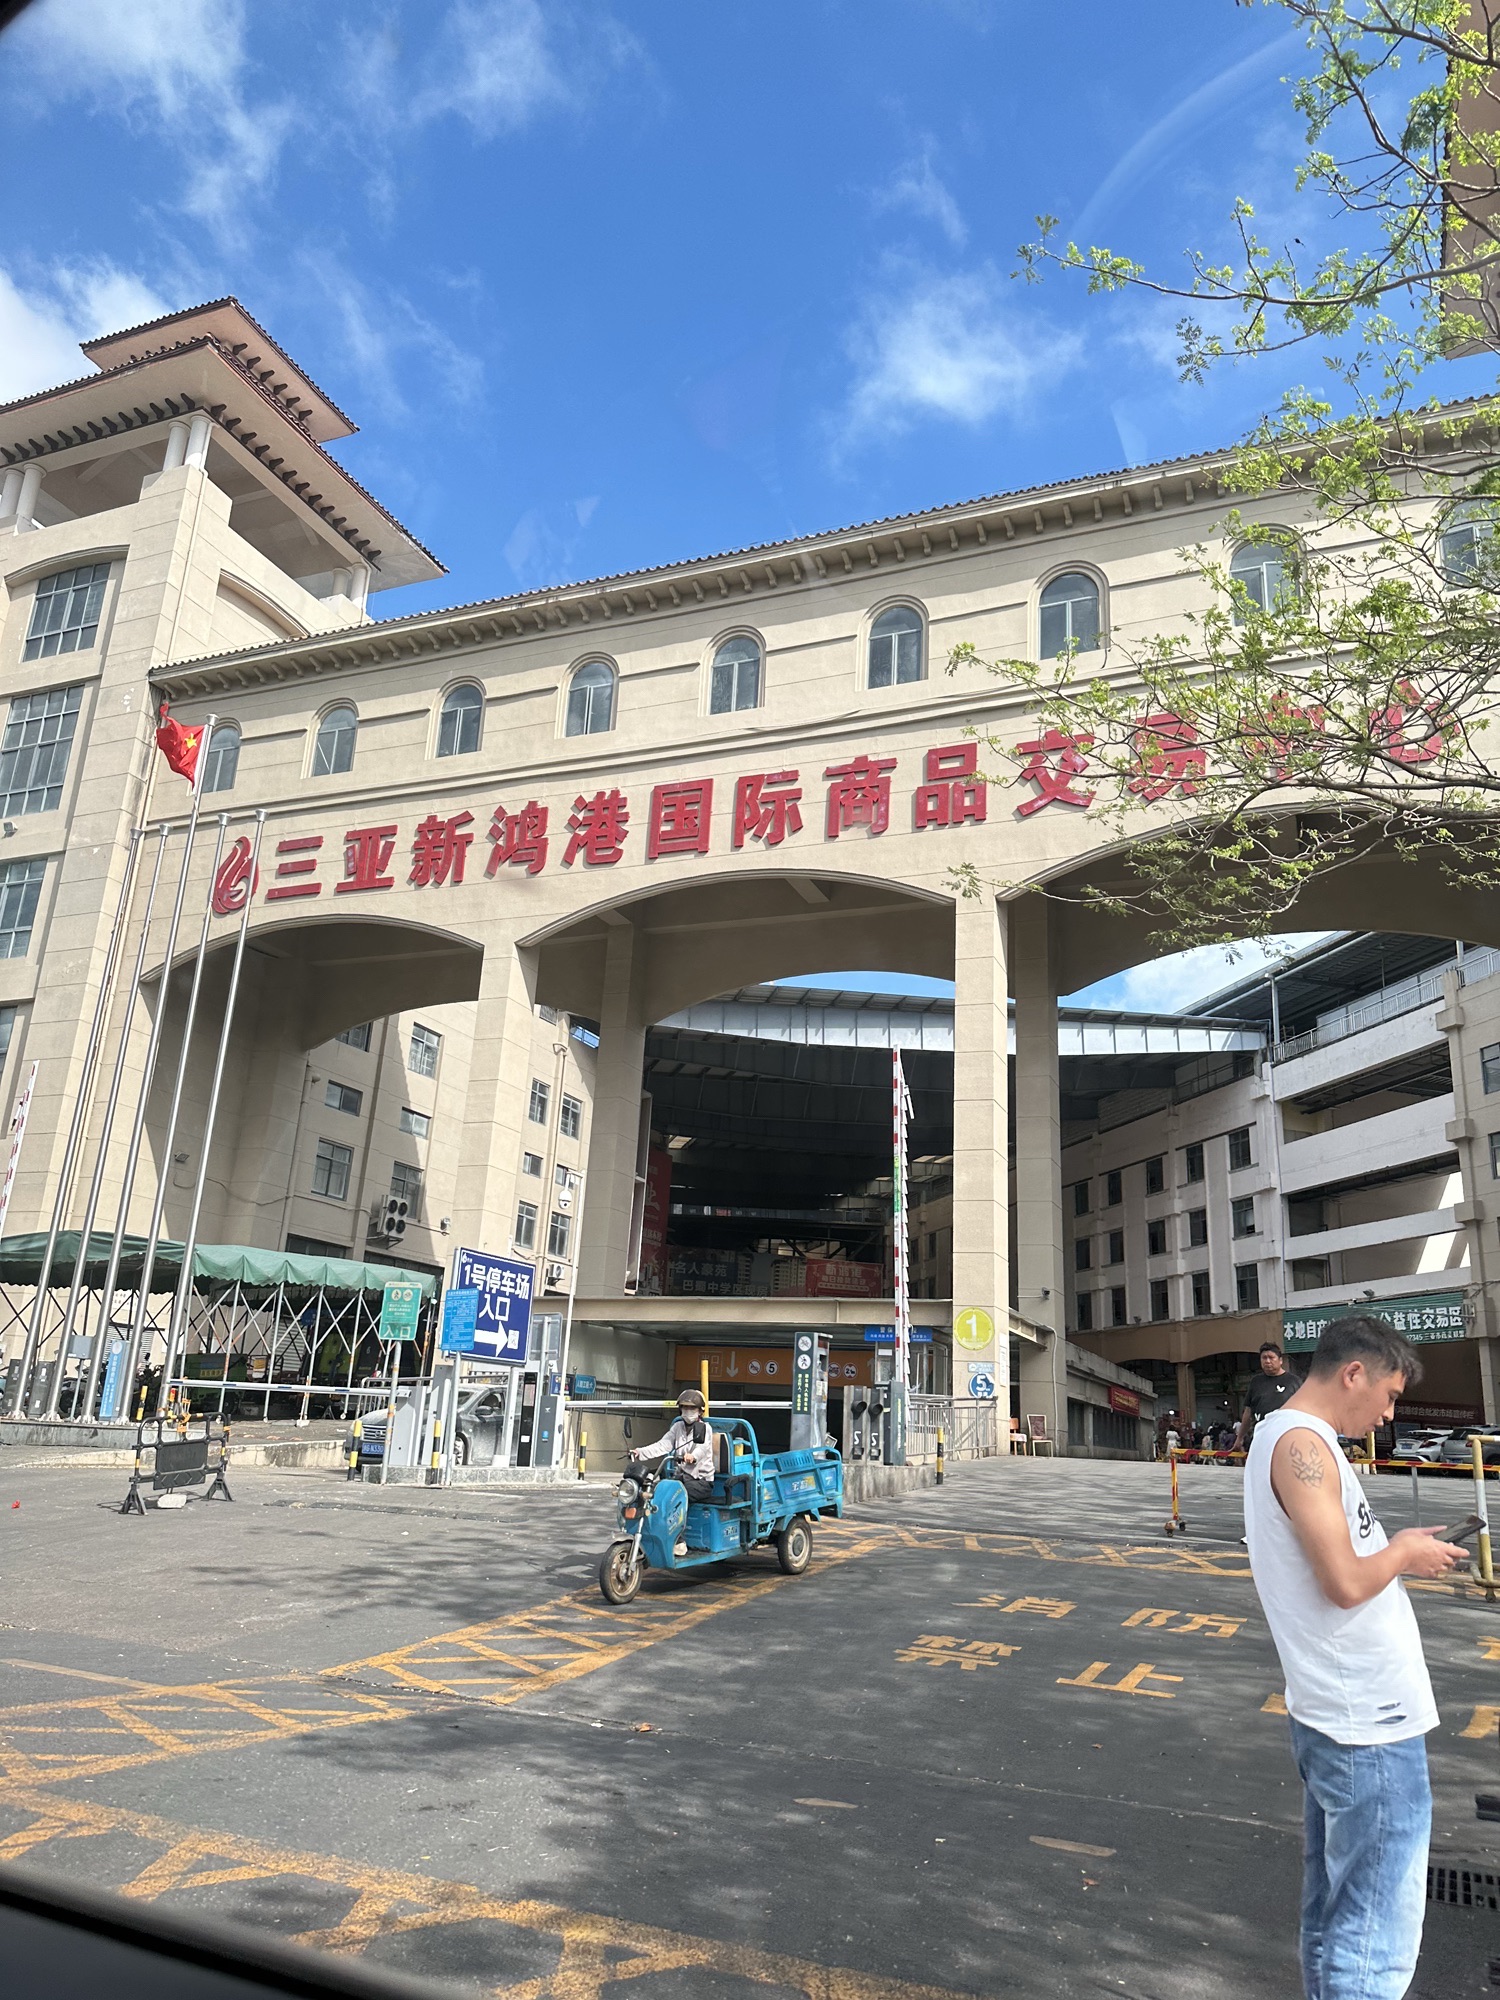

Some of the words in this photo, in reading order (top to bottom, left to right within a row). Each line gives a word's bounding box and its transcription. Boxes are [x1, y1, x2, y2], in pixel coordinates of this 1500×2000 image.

[464, 1263, 530, 1300] 1号停车场
[479, 1293, 511, 1321] 入口
[383, 1324, 411, 1339] 入口
[966, 1314, 978, 1341] 1
[768, 1363, 775, 1374] 5
[976, 1375, 987, 1391] 5
